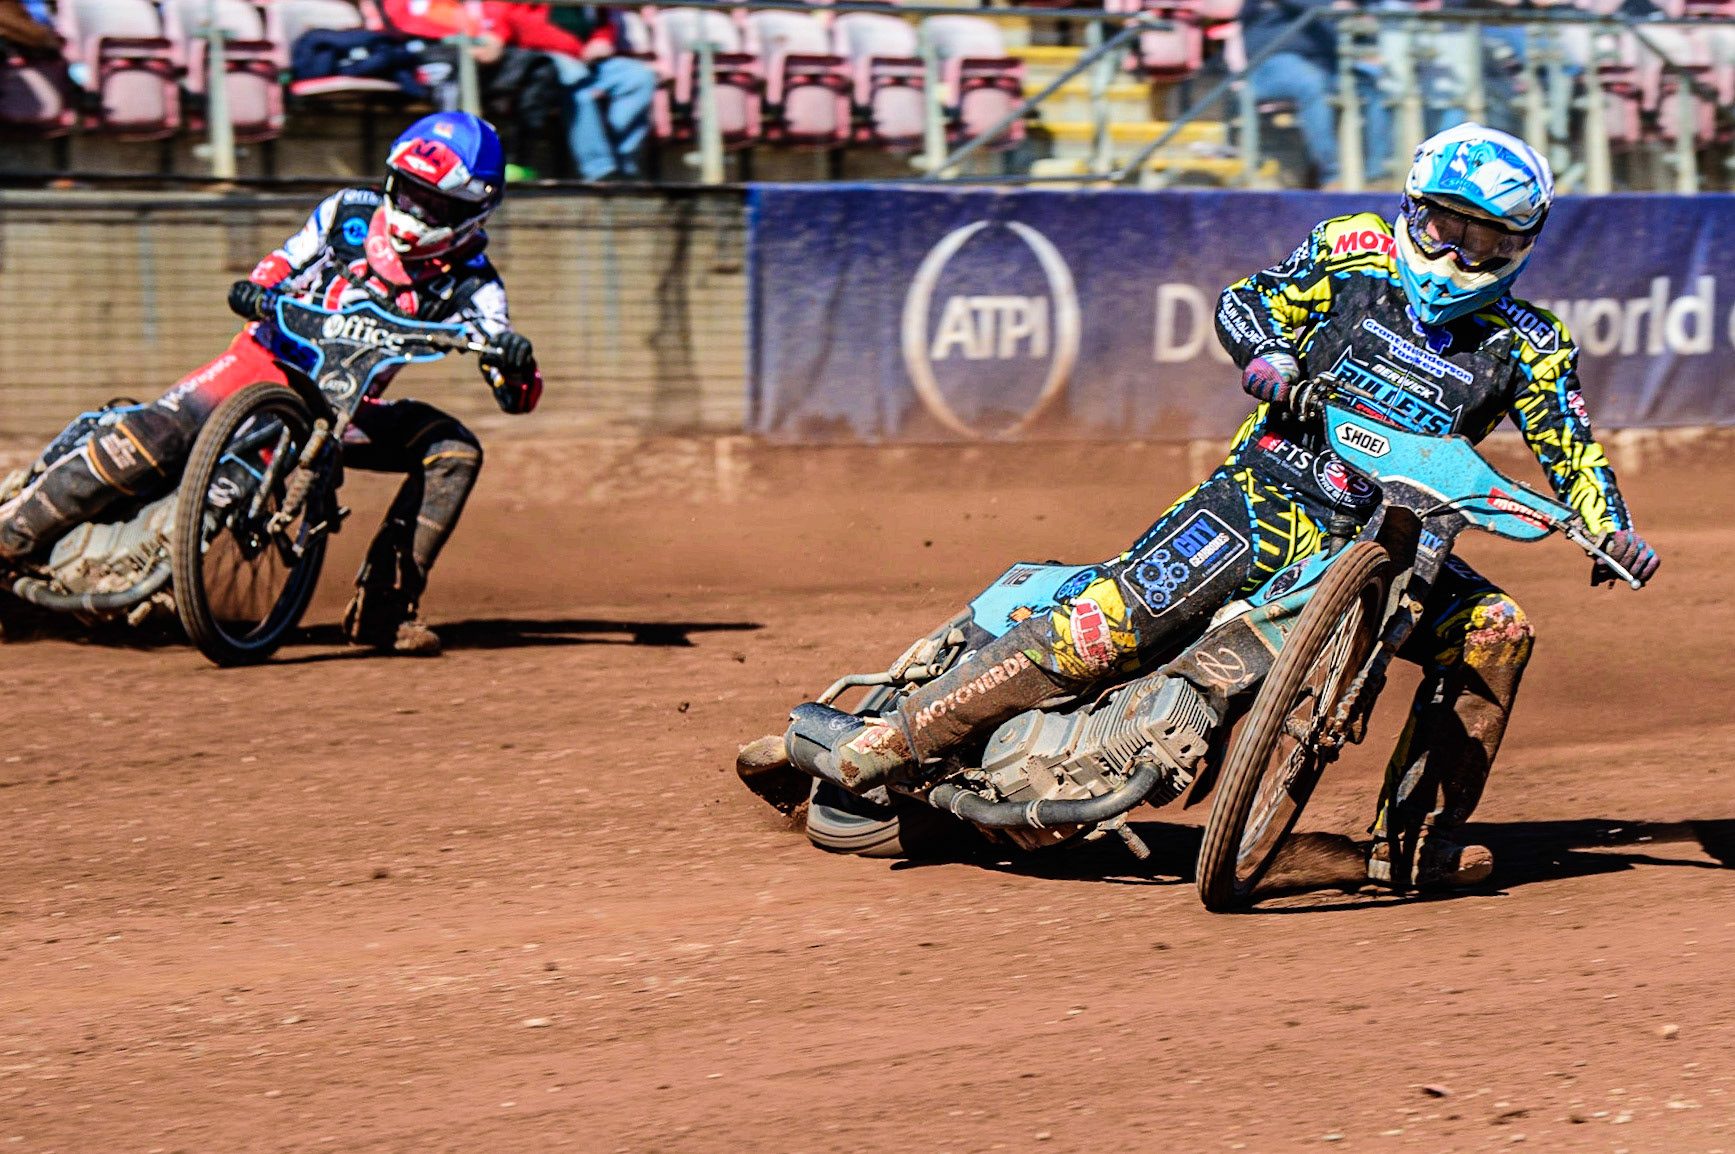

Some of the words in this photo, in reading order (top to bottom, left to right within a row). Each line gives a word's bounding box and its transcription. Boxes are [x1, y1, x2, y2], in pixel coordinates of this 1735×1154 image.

[322, 313, 406, 352] Office
[930, 296, 1050, 361] ATPI
[1496, 296, 1555, 349] SHOEI
[1365, 320, 1402, 346] Grant
[1402, 341, 1473, 383] Henderson
[1390, 344, 1445, 377] Tankers
[1371, 363, 1436, 399] BERWICK
[1273, 441, 1314, 470] FTS
[1341, 426, 1385, 454] SHOEI
[1171, 517, 1218, 559] CITY
[914, 651, 1032, 732] MOTOVERDE
